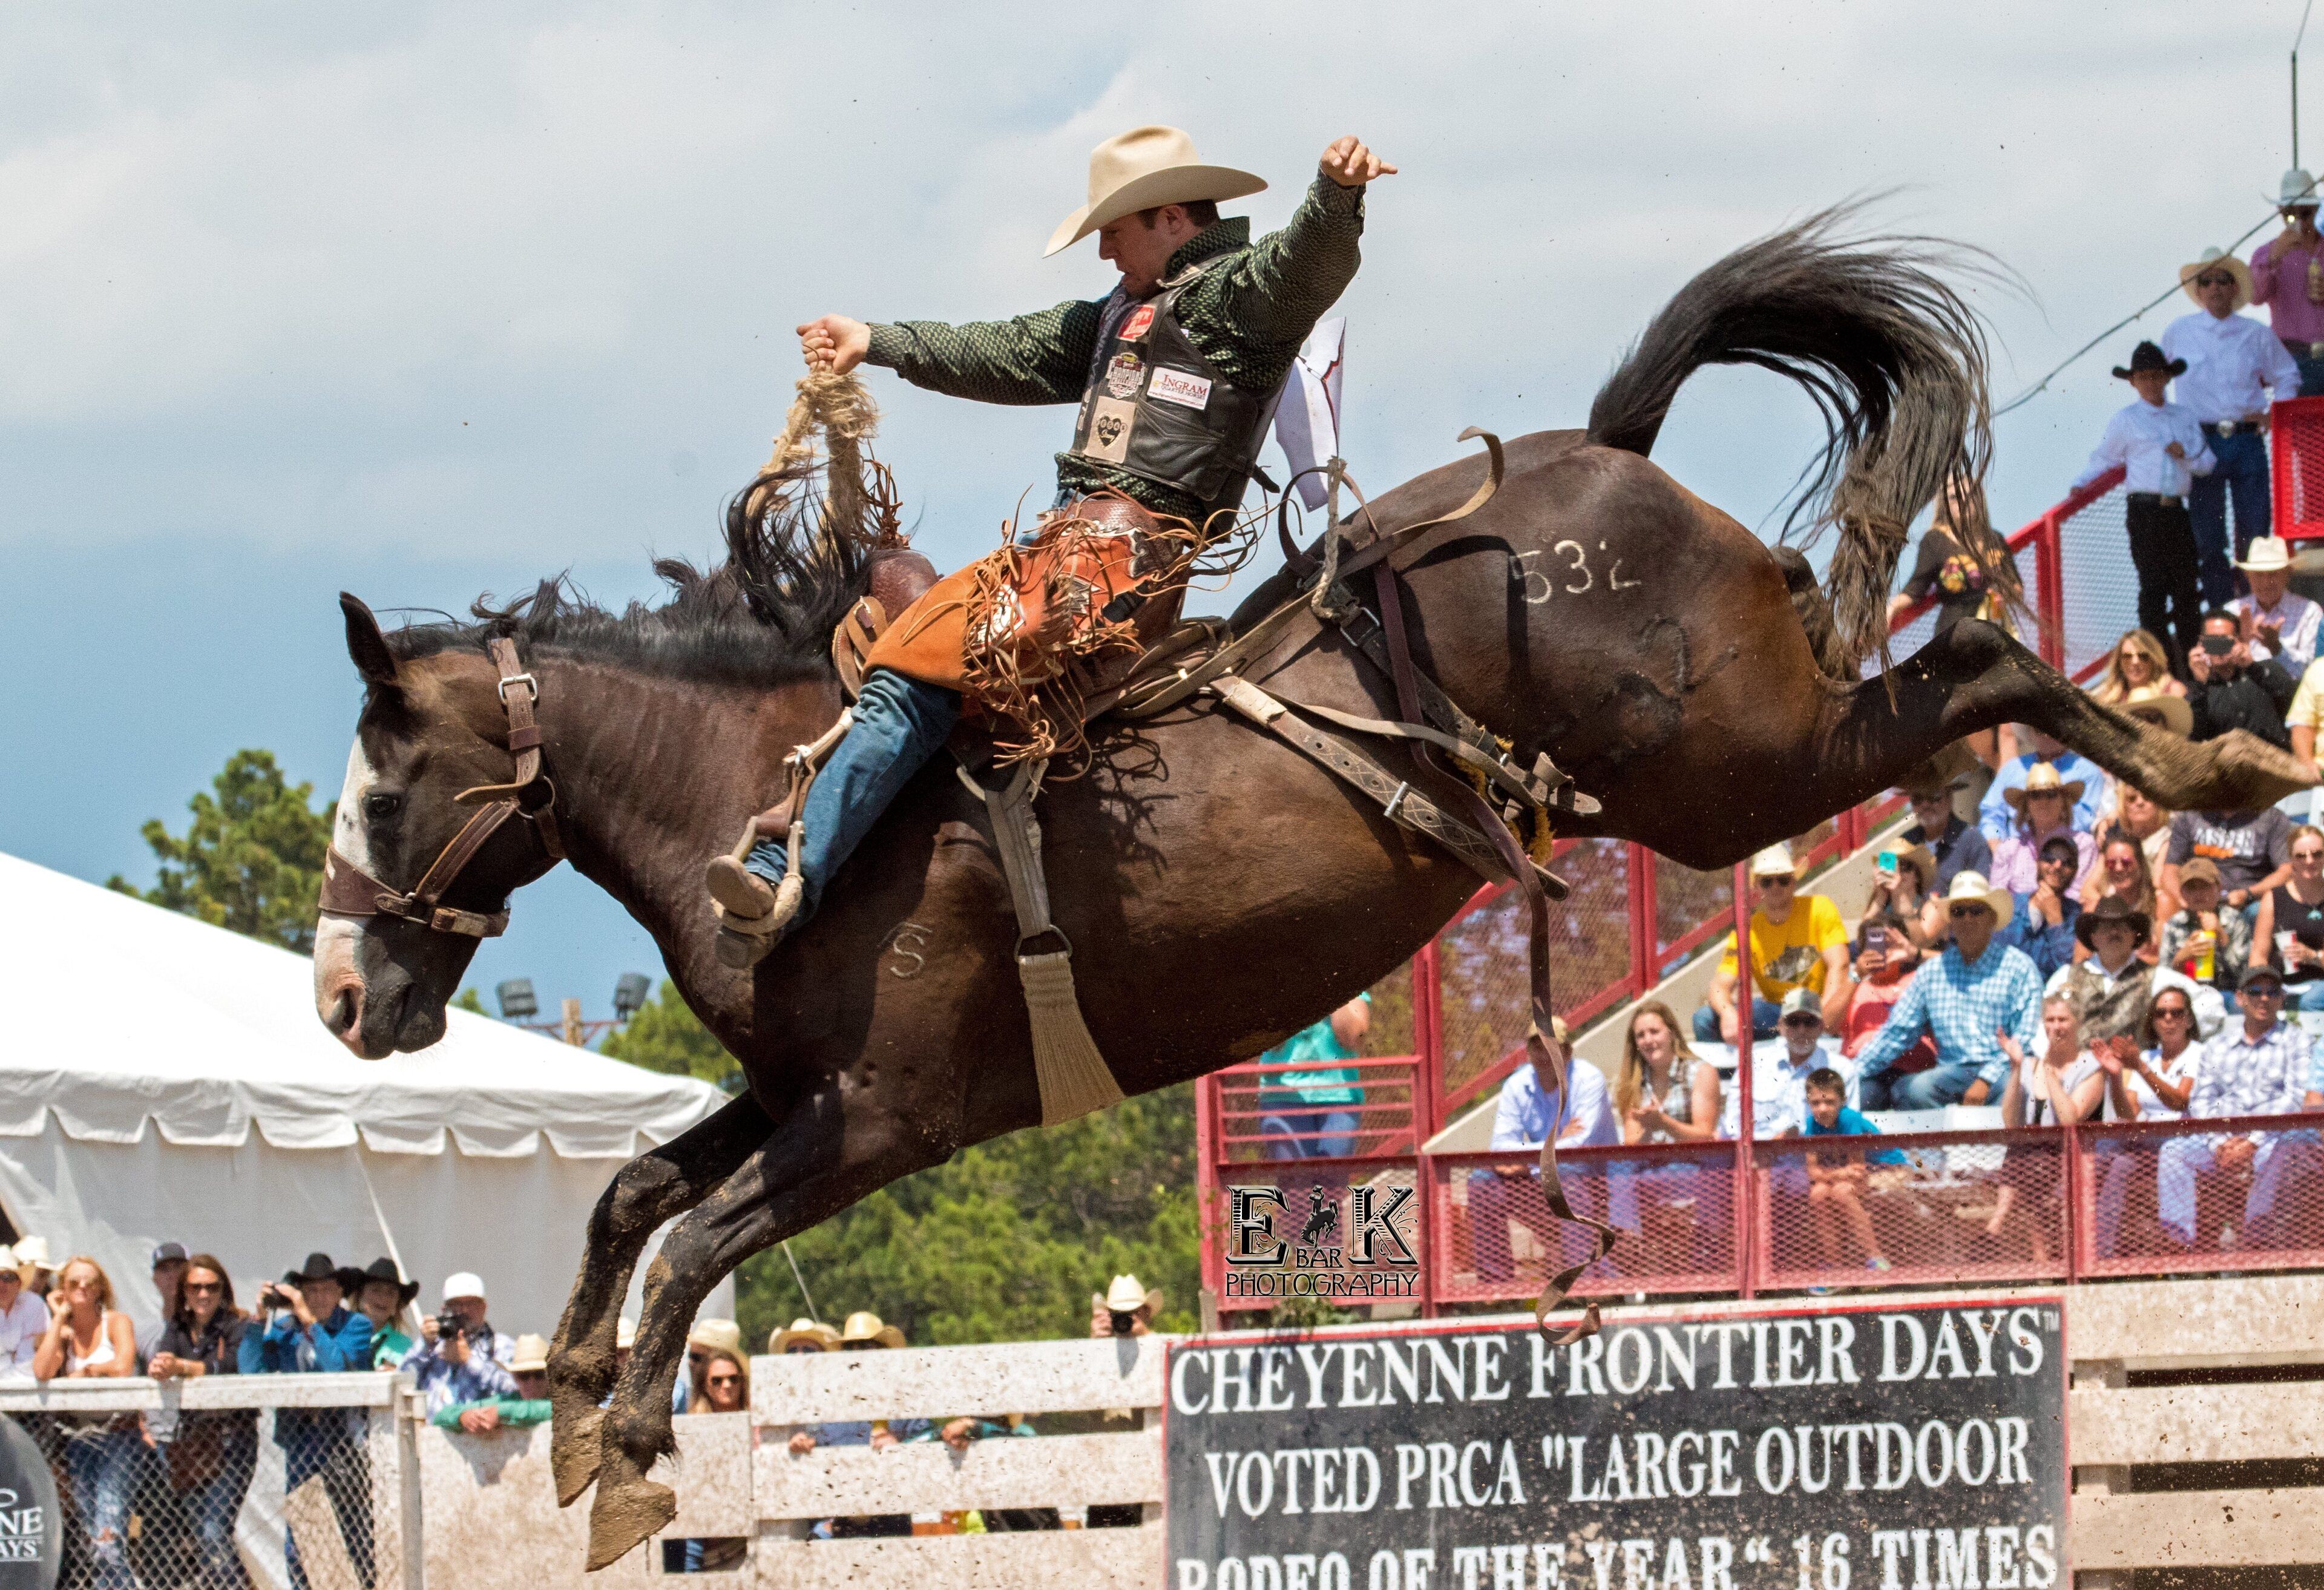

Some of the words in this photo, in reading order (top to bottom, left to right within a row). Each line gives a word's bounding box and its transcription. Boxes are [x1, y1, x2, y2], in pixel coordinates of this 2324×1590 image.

[1164, 374, 1208, 395] INGRAM
[1170, 1335, 1510, 1415] CHEYENNE
[1526, 1315, 1861, 1398] FRONTIER
[1877, 1307, 2043, 1382] DAYS
[1206, 1447, 1381, 1518] VOTED
[1395, 1437, 1528, 1510] PRCA
[1542, 1429, 1741, 1503] "LARGE
[1755, 1416, 2030, 1494] OUTDOOR
[1368, 1548, 1436, 1589] OF
[1453, 1543, 1566, 1589] THE
[1792, 1531, 1850, 1589] 16
[1871, 1525, 2058, 1589] TIMES
